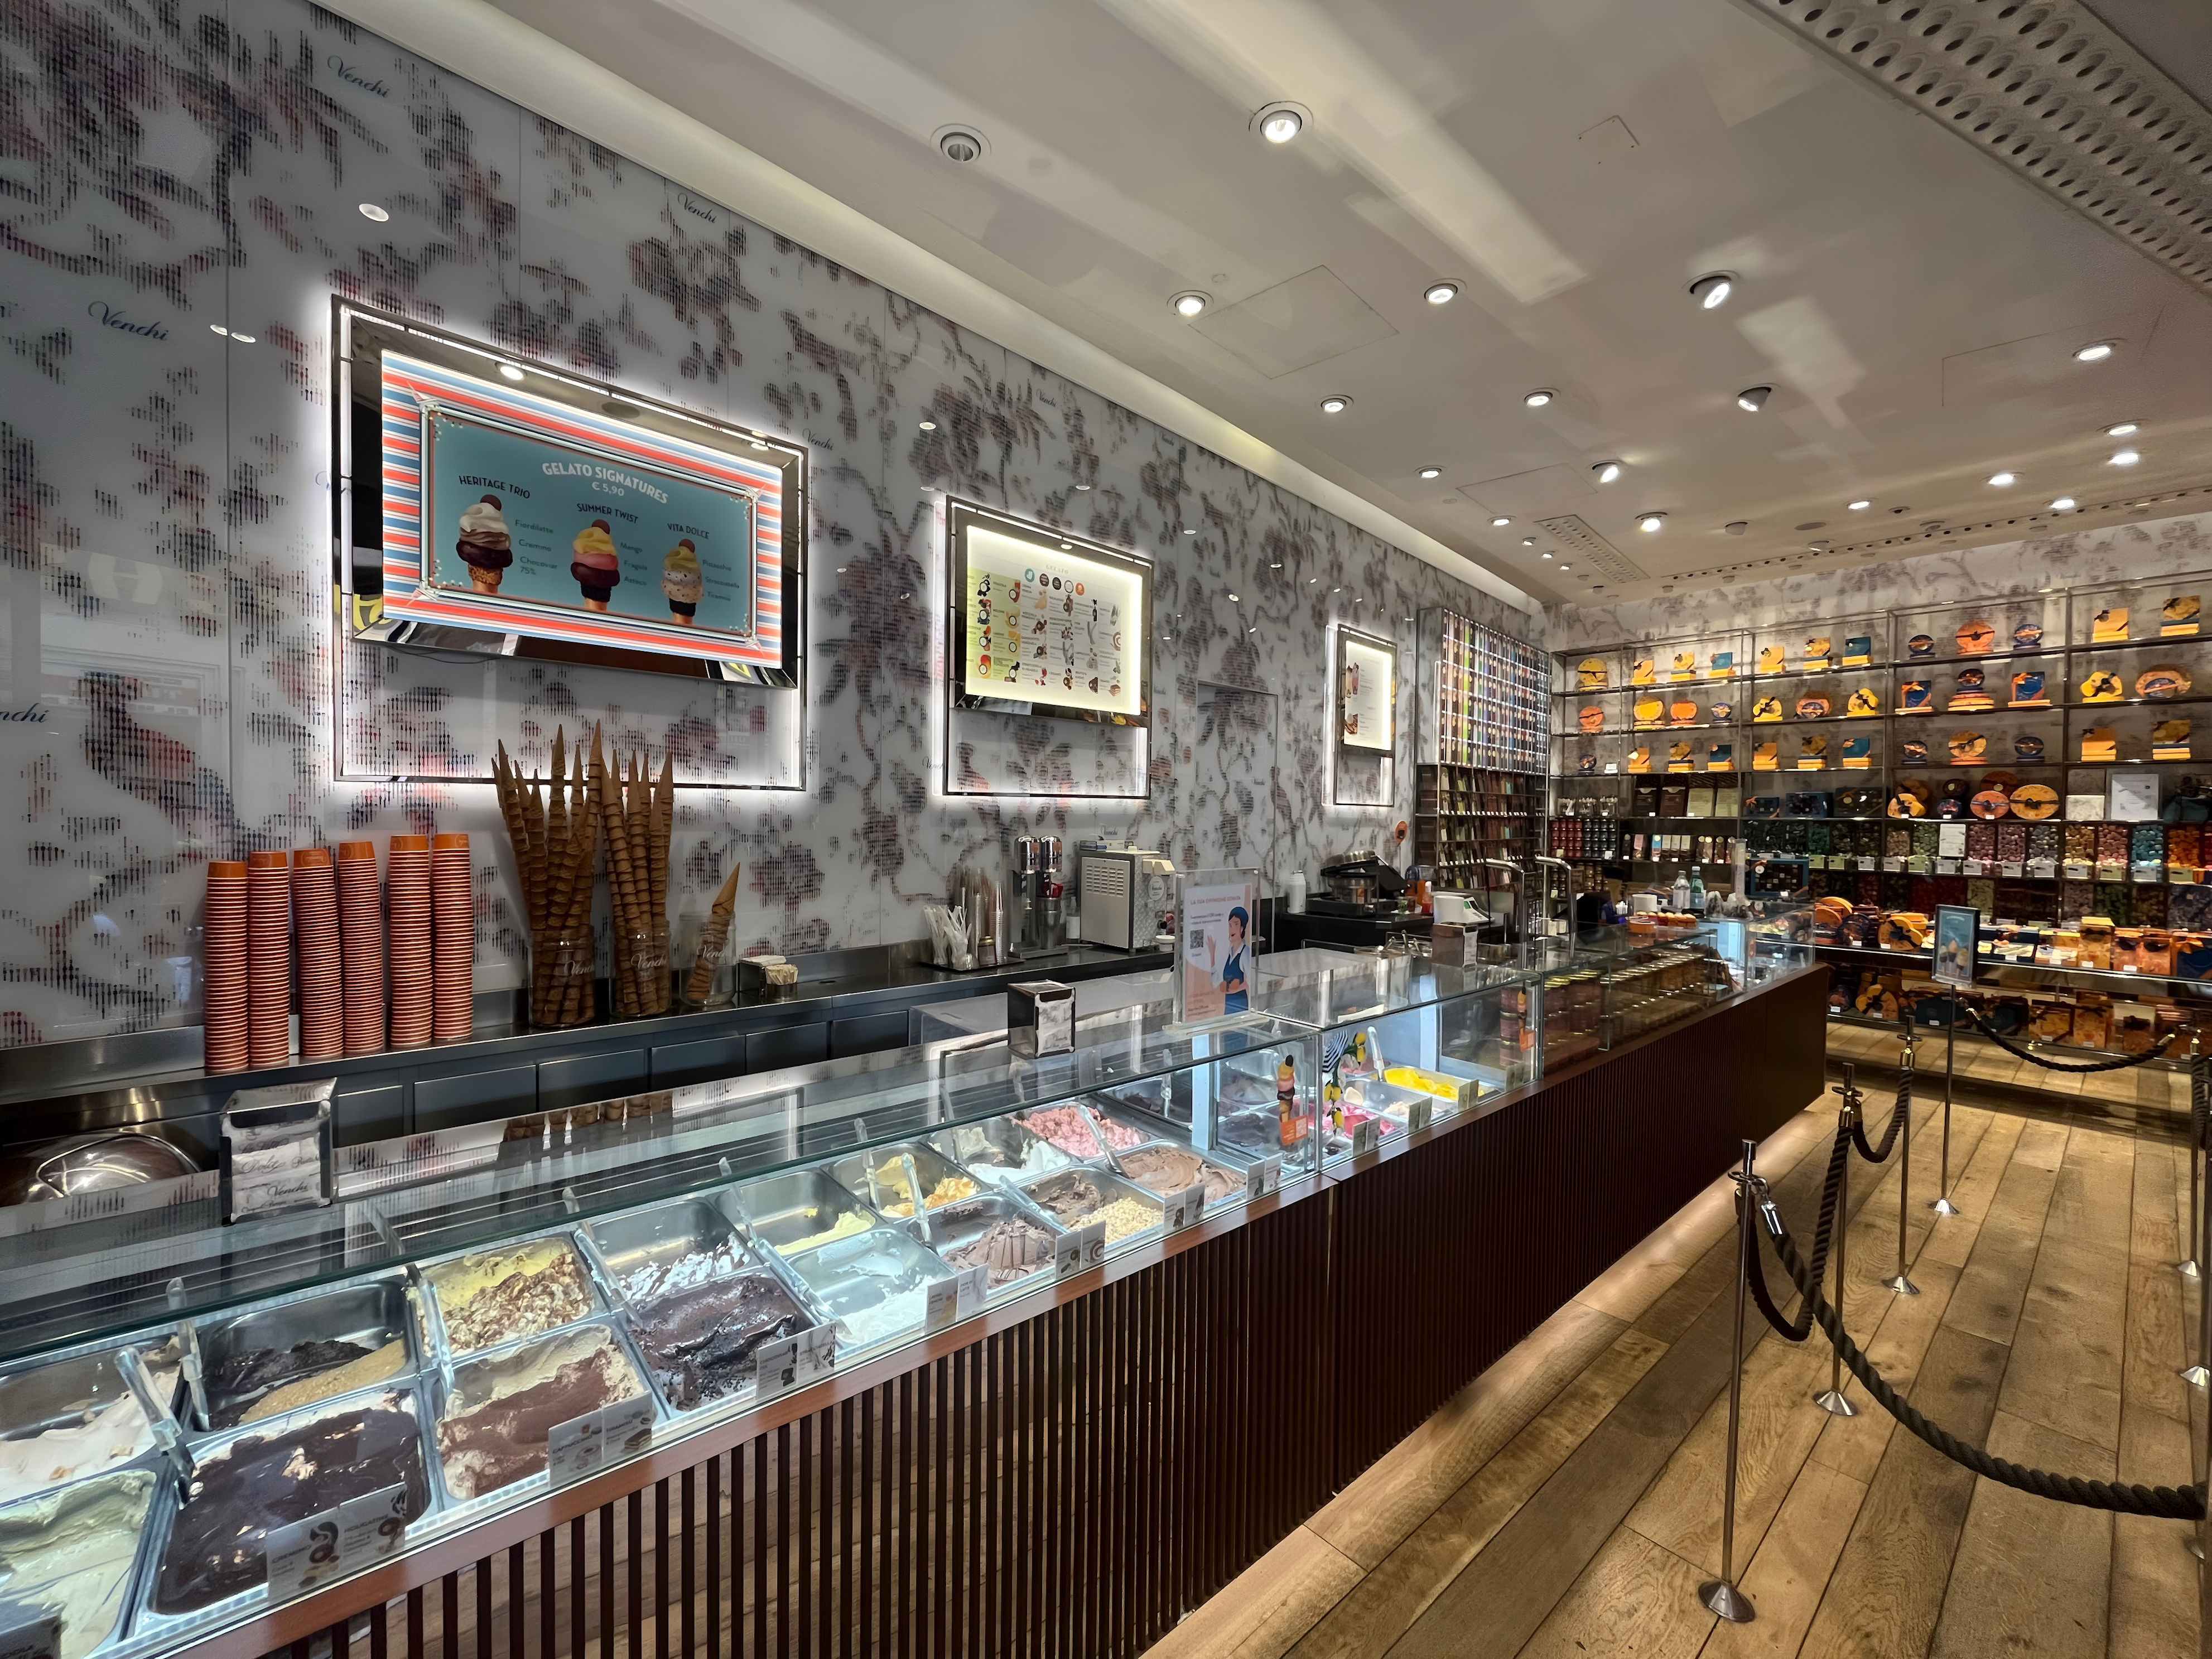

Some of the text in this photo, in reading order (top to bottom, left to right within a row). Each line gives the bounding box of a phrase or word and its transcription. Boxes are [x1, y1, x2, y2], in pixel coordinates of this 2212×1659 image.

[327, 55, 391, 98] Venchi
[677, 192, 716, 224] Venchi
[87, 300, 170, 342] Venchi
[802, 428, 835, 451] Venchi
[459, 475, 531, 499] HERITAGE TRIO
[542, 462, 669, 504] GELATO SIGNATURES
[591, 481, 625, 496] € 5,90
[577, 503, 639, 524] SUMMER TWIST
[515, 519, 554, 534] Fiordilatte
[667, 522, 710, 539] VITA DOLCE
[518, 539, 552, 552] Cremino
[0, 702, 50, 723] nchi
[267, 1181, 308, 1197] Venchi
[552, 1434, 594, 1454] CAPPUCCINO
[272, 1544, 312, 1564] CREMINO
